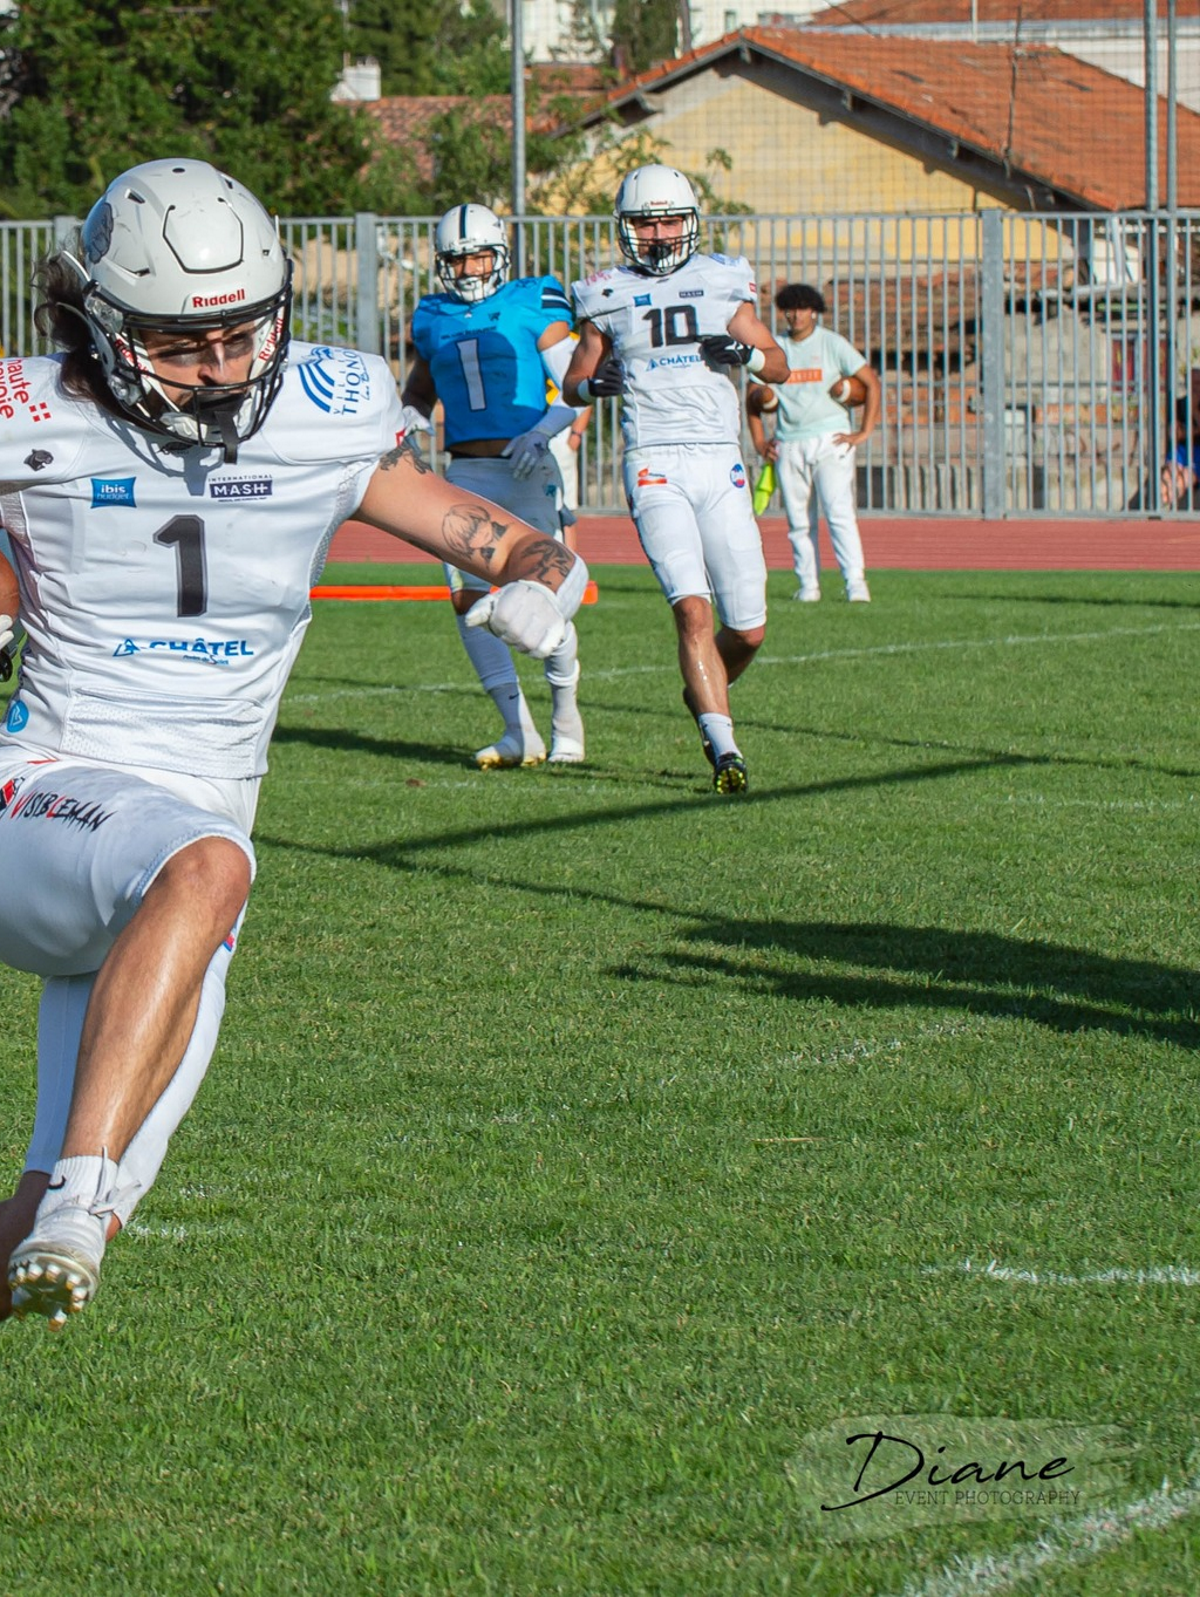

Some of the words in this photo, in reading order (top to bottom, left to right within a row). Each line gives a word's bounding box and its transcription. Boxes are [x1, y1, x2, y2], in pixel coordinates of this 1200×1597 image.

[192, 289, 246, 308] Riddell
[642, 304, 699, 348] 10
[456, 338, 486, 412] 1
[101, 484, 126, 493] ibis
[208, 474, 273, 482] INTERNATIONAL
[153, 514, 208, 618] 1
[10, 786, 118, 833] VISIBLEMAN
